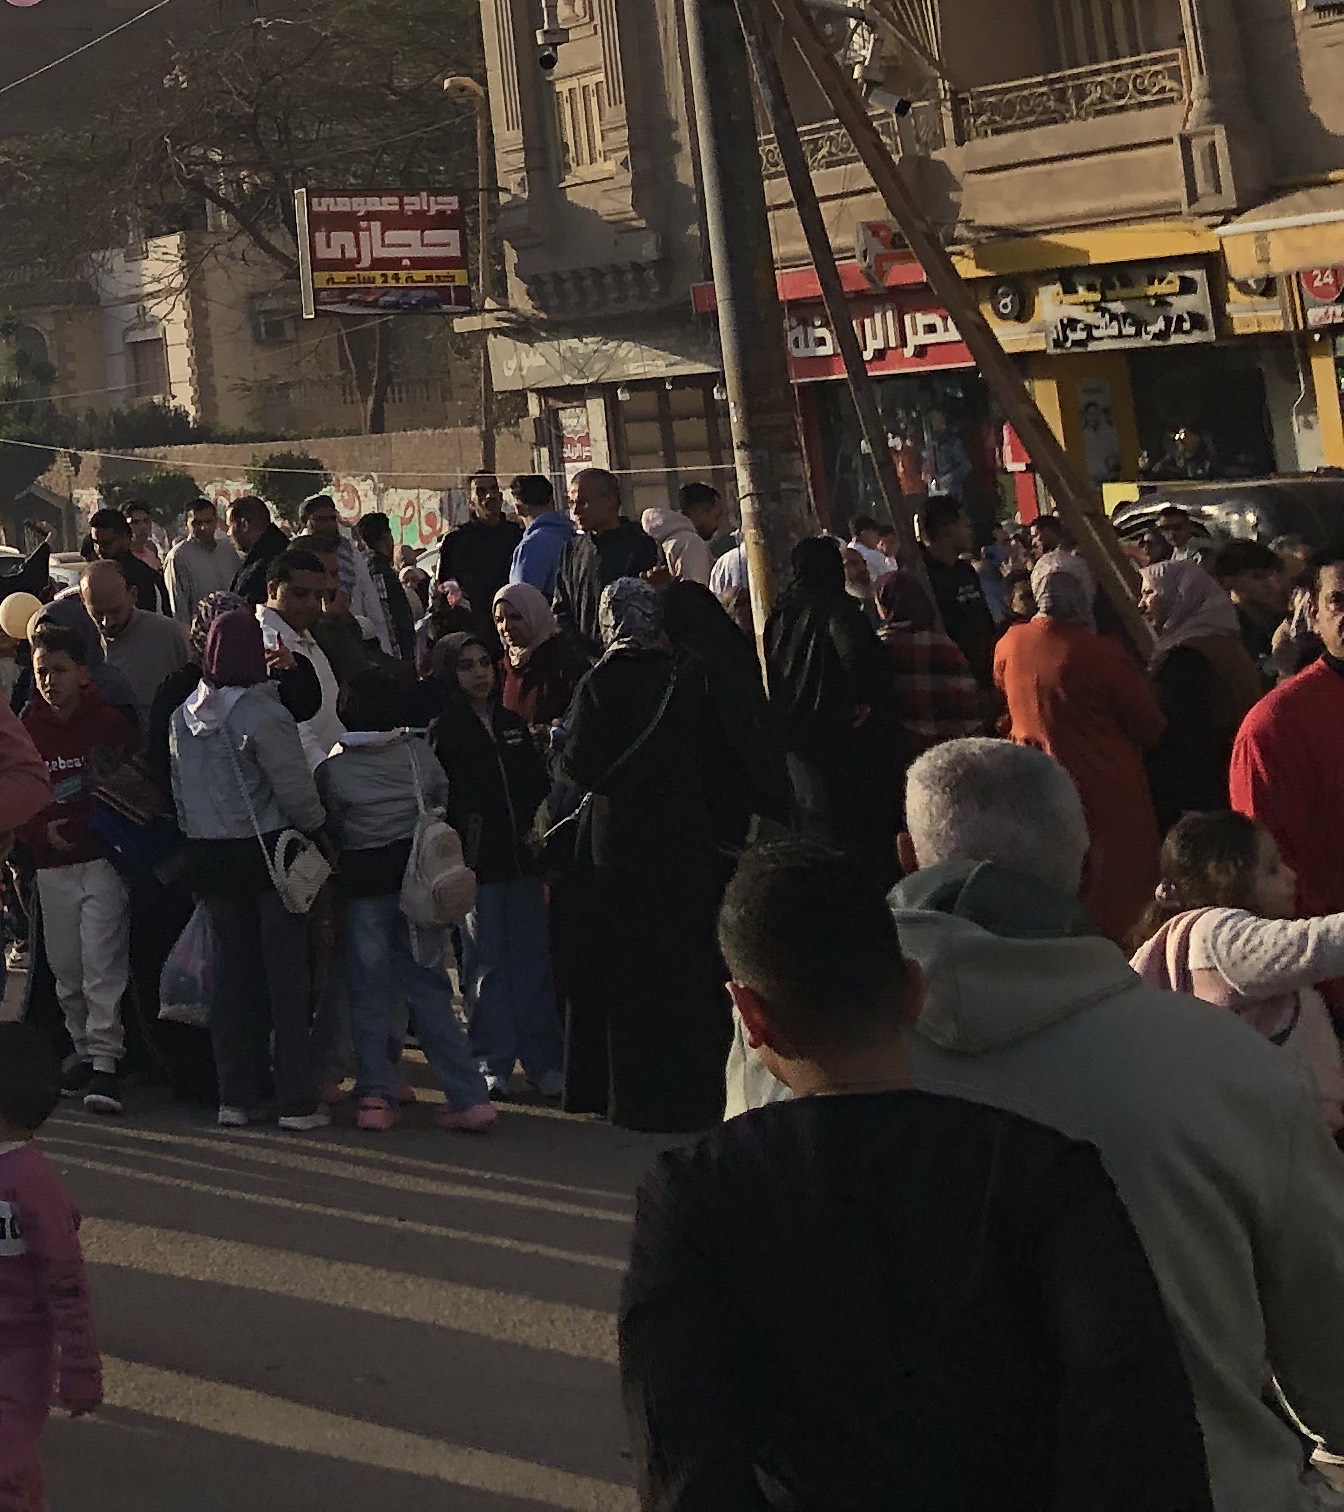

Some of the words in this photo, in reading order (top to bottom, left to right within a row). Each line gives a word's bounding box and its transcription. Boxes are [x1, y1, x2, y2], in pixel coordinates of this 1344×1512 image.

[403, 191, 459, 215] جراج
[325, 272, 376, 286] ساعة
[380, 272, 401, 285] 24
[404, 271, 456, 285] خدمة
[1312, 269, 1334, 288] 24
